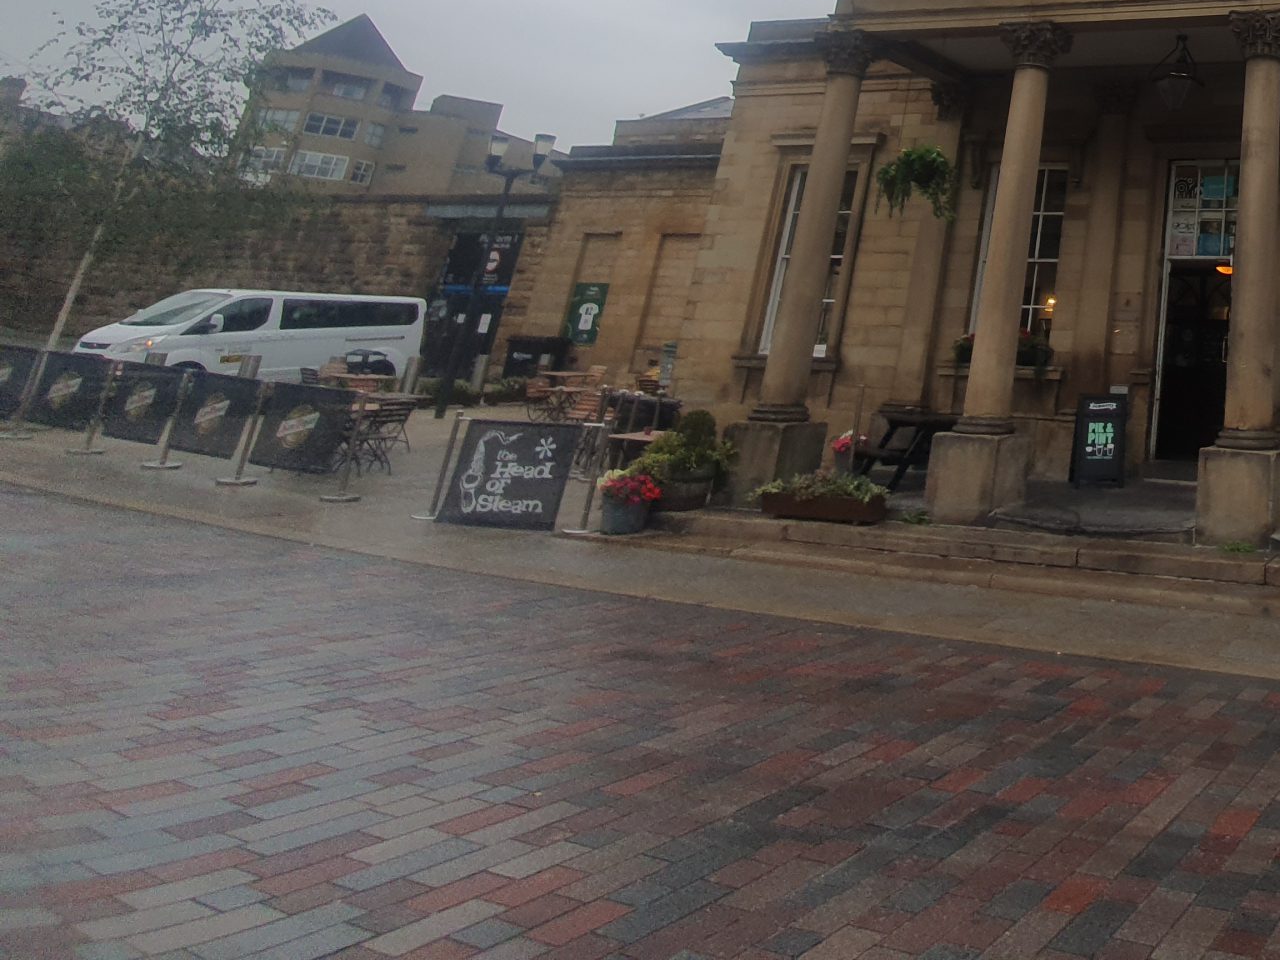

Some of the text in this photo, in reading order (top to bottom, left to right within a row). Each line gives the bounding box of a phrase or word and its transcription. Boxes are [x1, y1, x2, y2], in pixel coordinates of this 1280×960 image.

[1087, 432, 1114, 445] PINT
[496, 450, 518, 461] the
[490, 461, 556, 479] Head
[485, 477, 512, 494] of
[475, 494, 543, 514] Steam
